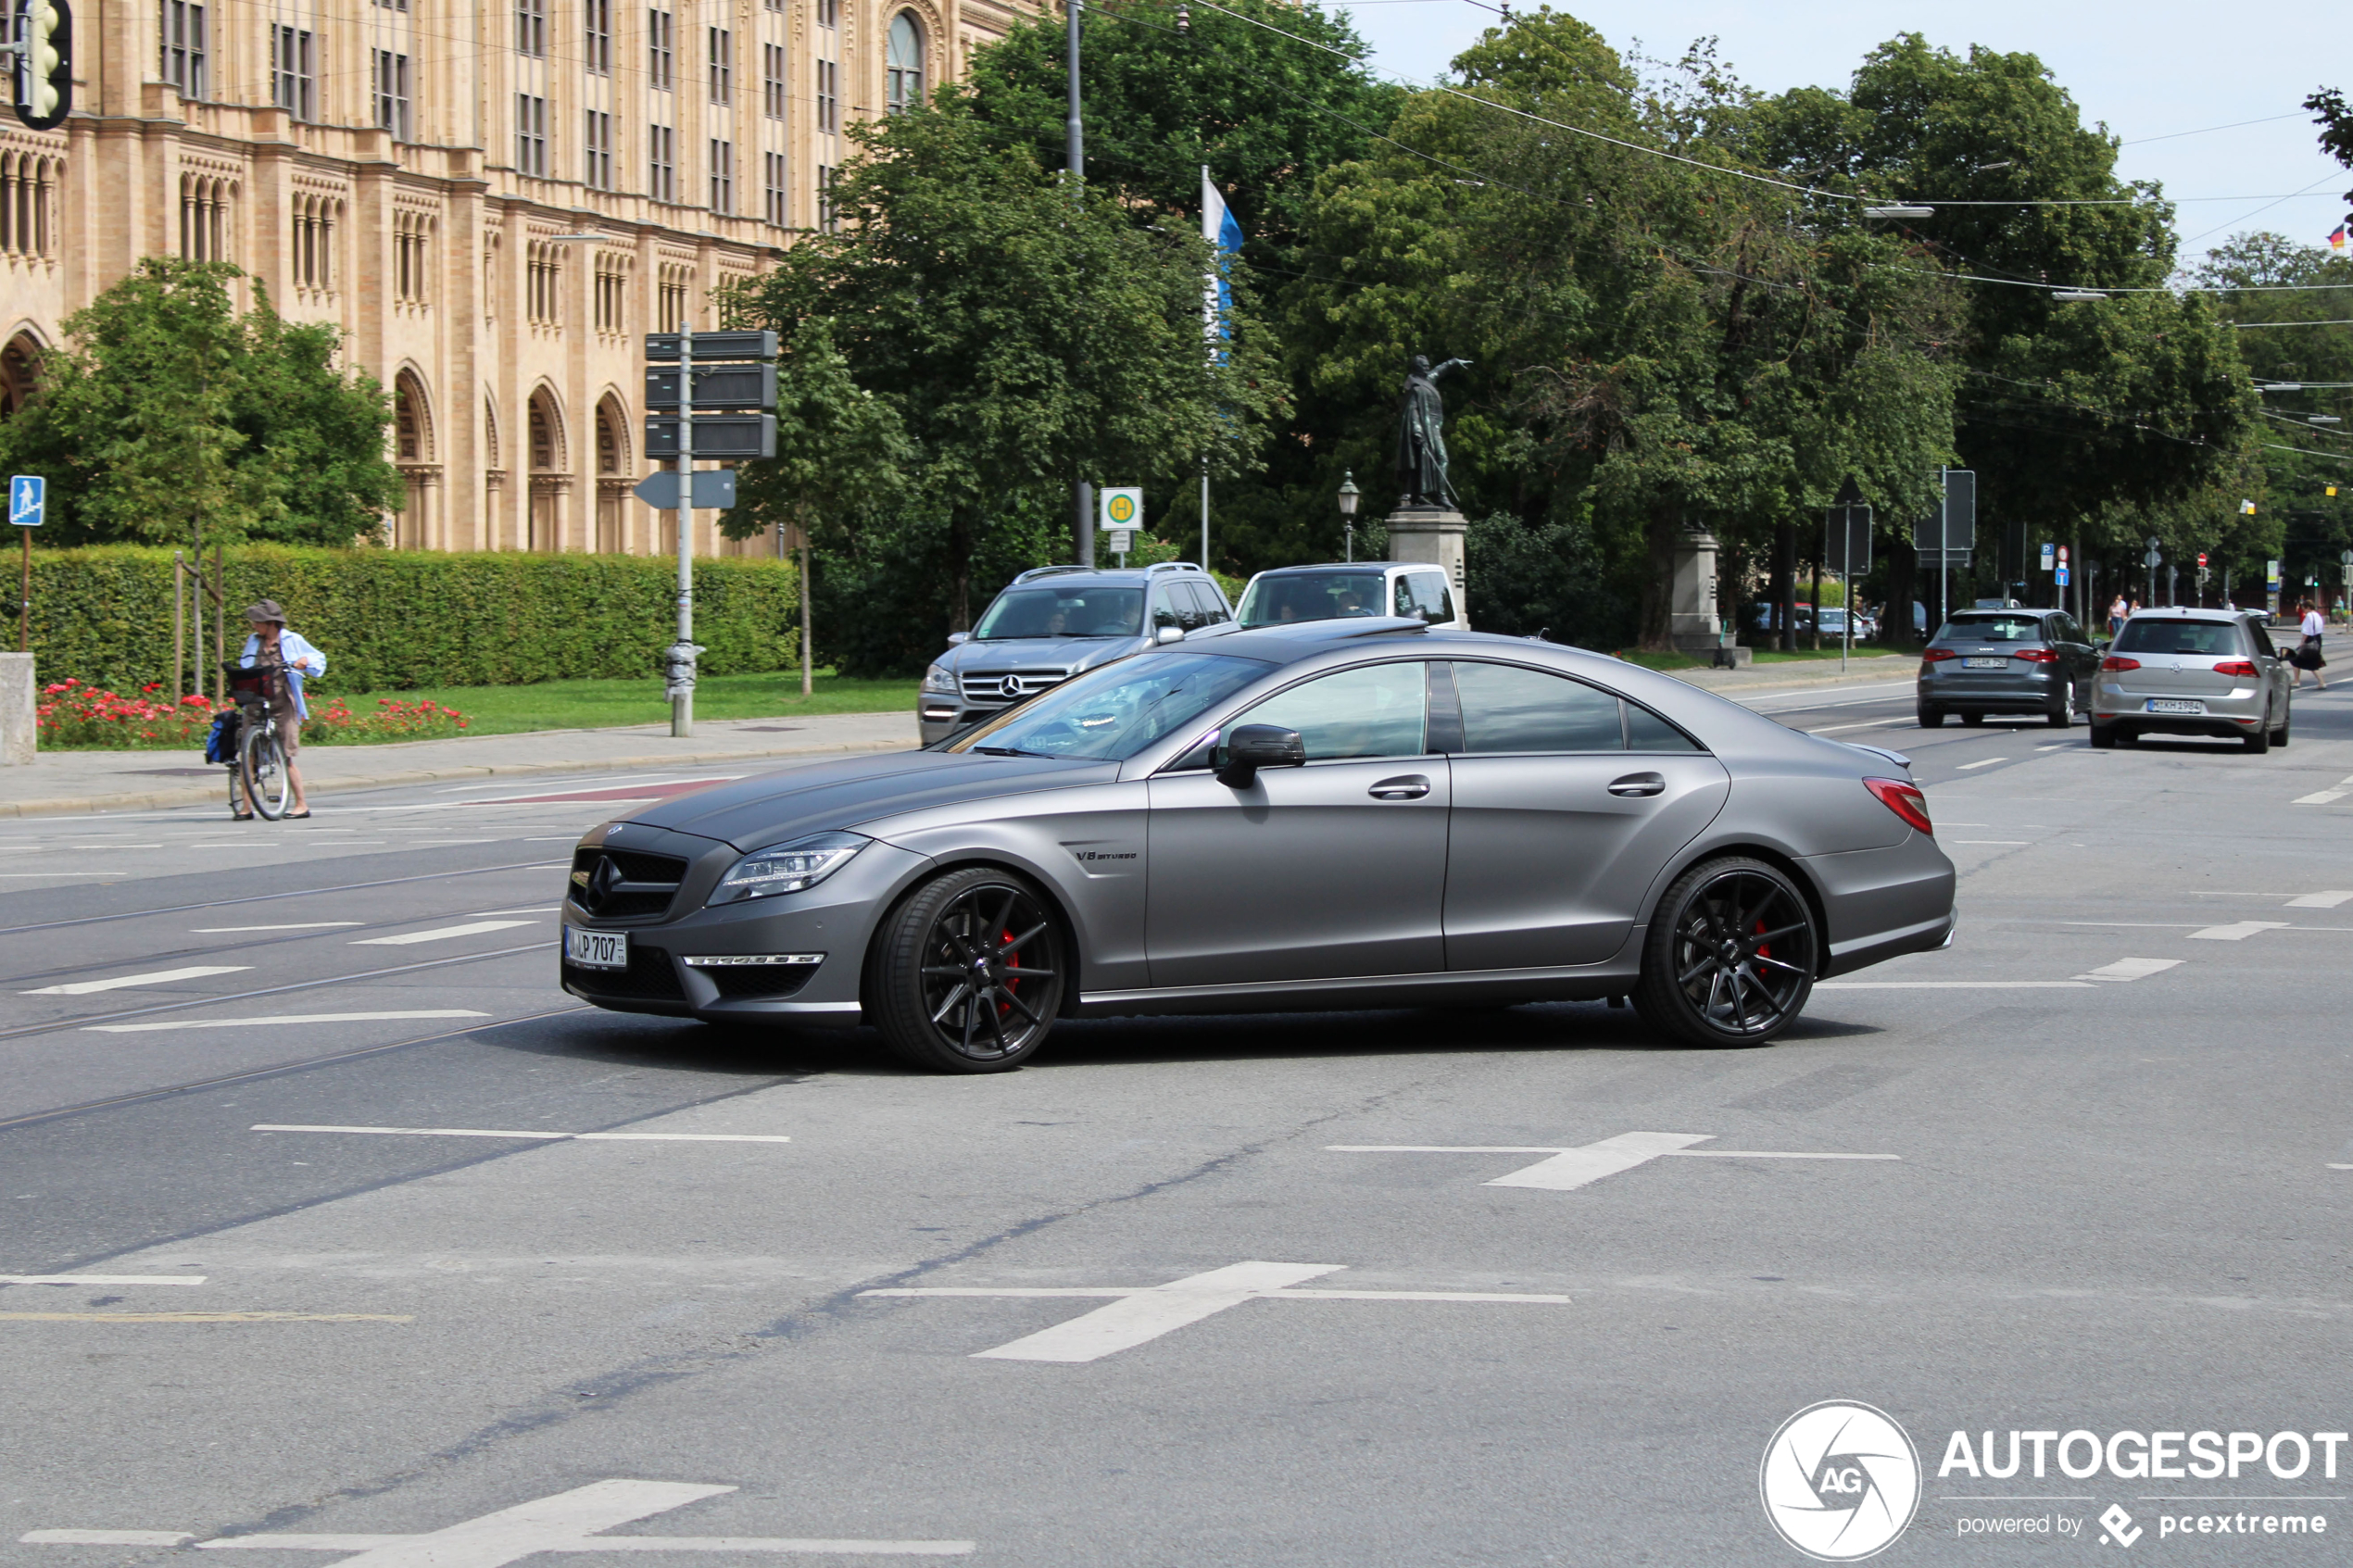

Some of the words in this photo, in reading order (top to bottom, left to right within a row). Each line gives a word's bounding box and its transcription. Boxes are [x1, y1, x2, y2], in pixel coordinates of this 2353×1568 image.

[1115, 500, 1127, 517] H
[1076, 851, 1096, 860] V8
[592, 936, 615, 961] 707
